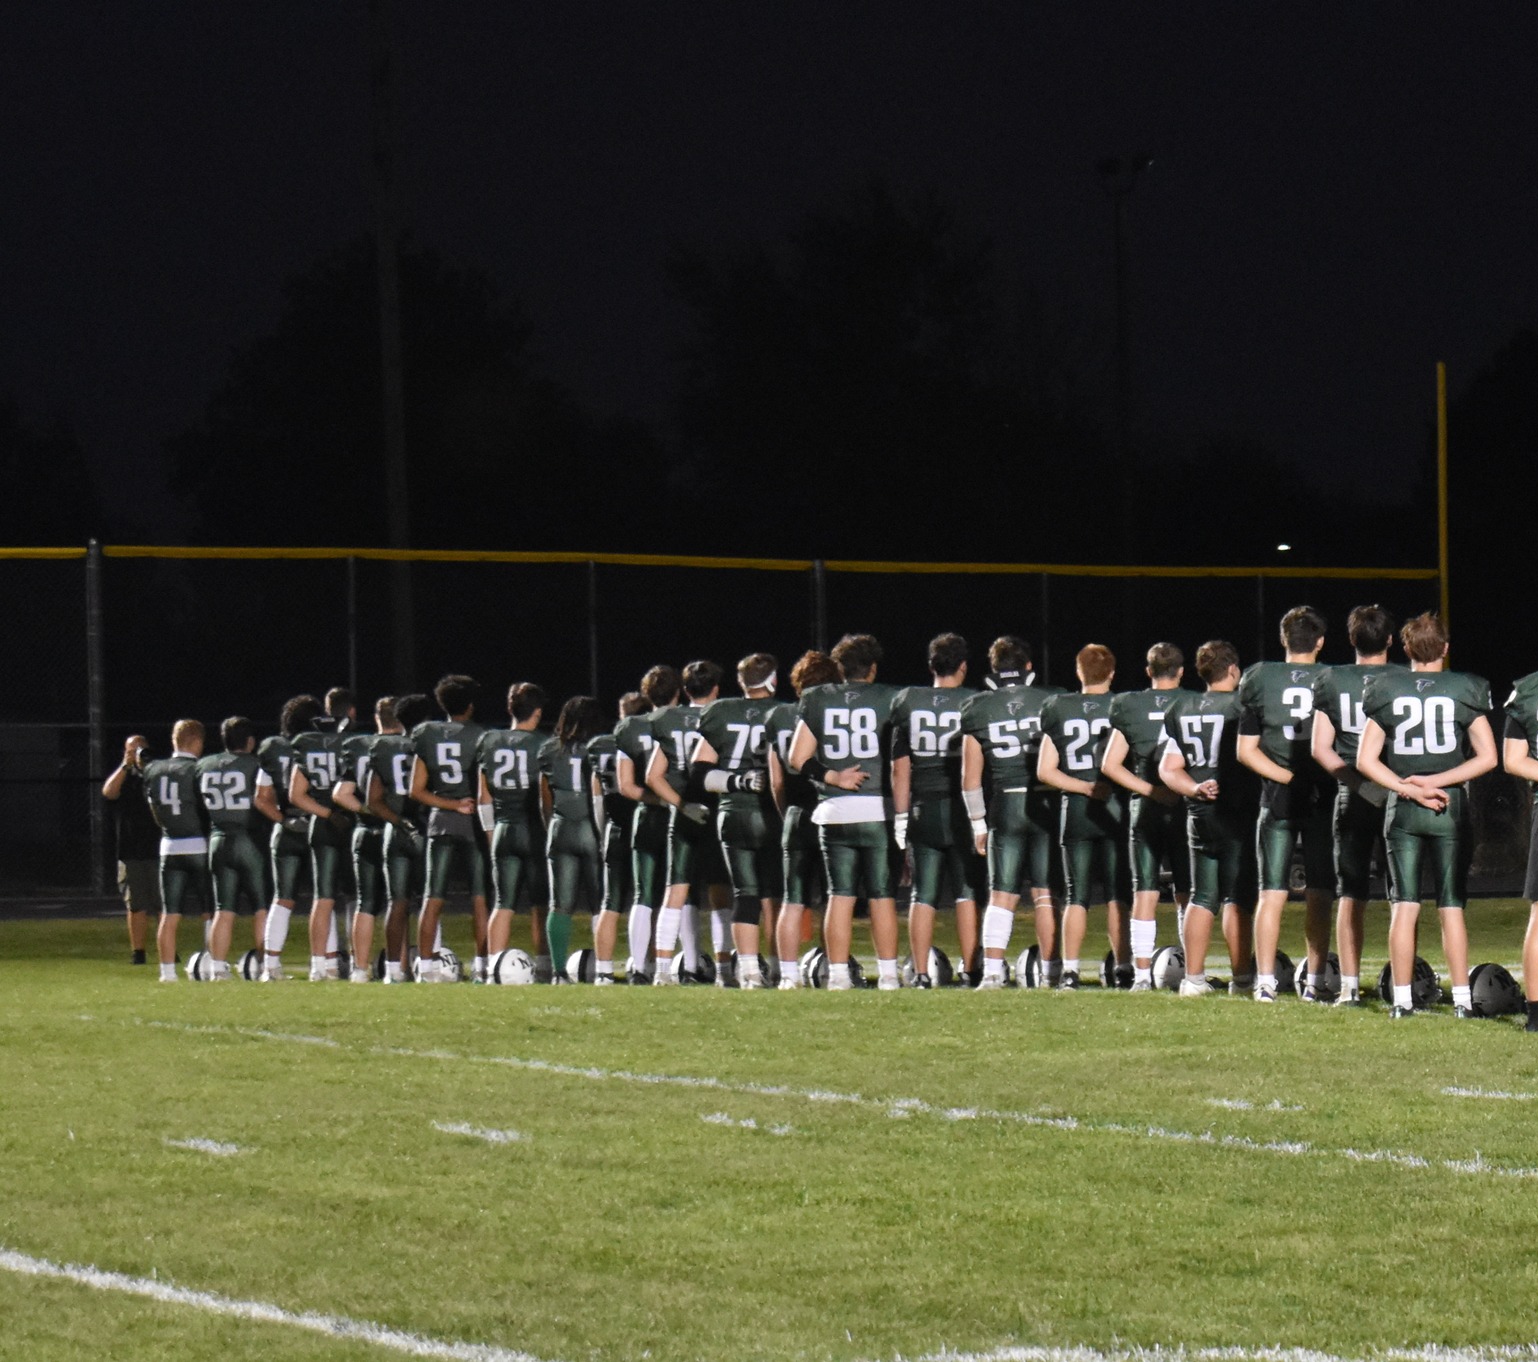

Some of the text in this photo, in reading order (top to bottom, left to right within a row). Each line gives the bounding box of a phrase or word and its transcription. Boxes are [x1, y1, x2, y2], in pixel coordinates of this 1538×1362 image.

[824, 708, 879, 760] 58
[910, 710, 961, 757] 62
[1282, 687, 1314, 740] 3
[1393, 696, 1457, 755] 20
[437, 743, 463, 784] 5
[1180, 715, 1224, 768] 57
[201, 771, 250, 810] 52
[493, 749, 530, 789] 21
[569, 757, 583, 792] 1
[160, 776, 182, 815] 4
